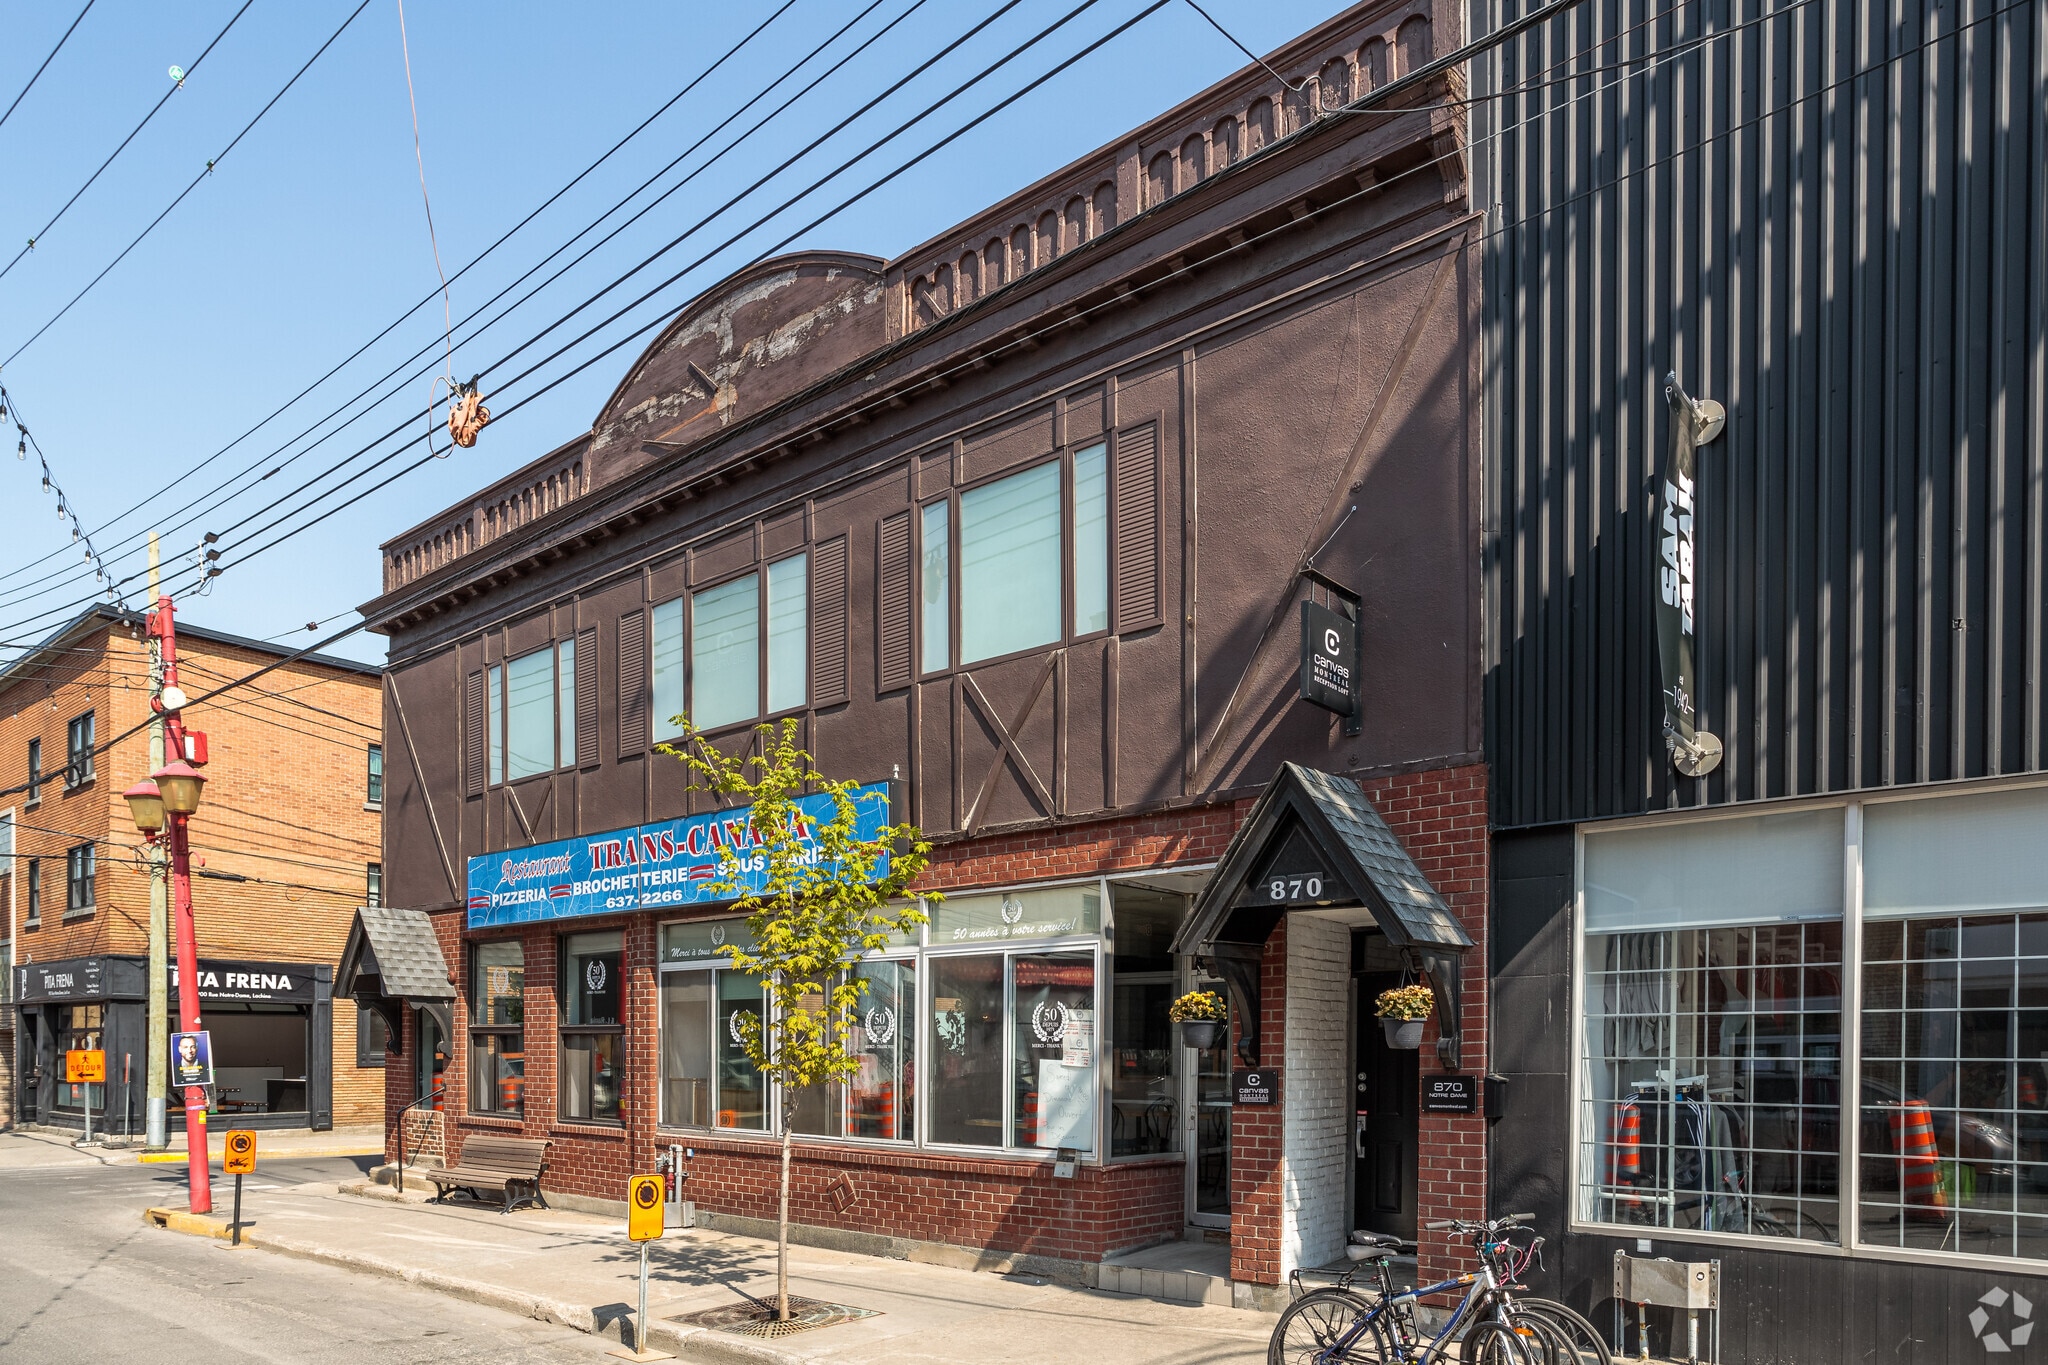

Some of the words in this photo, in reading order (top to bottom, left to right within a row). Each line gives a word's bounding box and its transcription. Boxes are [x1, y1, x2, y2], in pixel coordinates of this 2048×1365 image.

[1661, 478, 1680, 609] SAM
[1314, 653, 1349, 678] canvas
[1314, 665, 1349, 688] MONTREAL
[1673, 685, 1689, 714] 1942
[501, 851, 570, 886] Restaurant
[589, 808, 811, 872] TRANS-CANAA
[492, 888, 547, 907] PIZZERIA
[573, 867, 689, 895] BROCHETTERIE
[1270, 877, 1322, 900] 870
[606, 889, 683, 909] 637-2266
[953, 927, 968, 940] 50
[969, 927, 999, 939] années
[1002, 926, 1009, 936] à
[1012, 924, 1035, 935] votre
[1038, 917, 1077, 933] service!
[671, 947, 690, 958] Merci
[56, 973, 74, 988] FRENA
[226, 972, 293, 990] FRENA
[874, 1012, 886, 1025] 50
[1043, 1008, 1058, 1021] 50
[1434, 1082, 1463, 1092] 870
